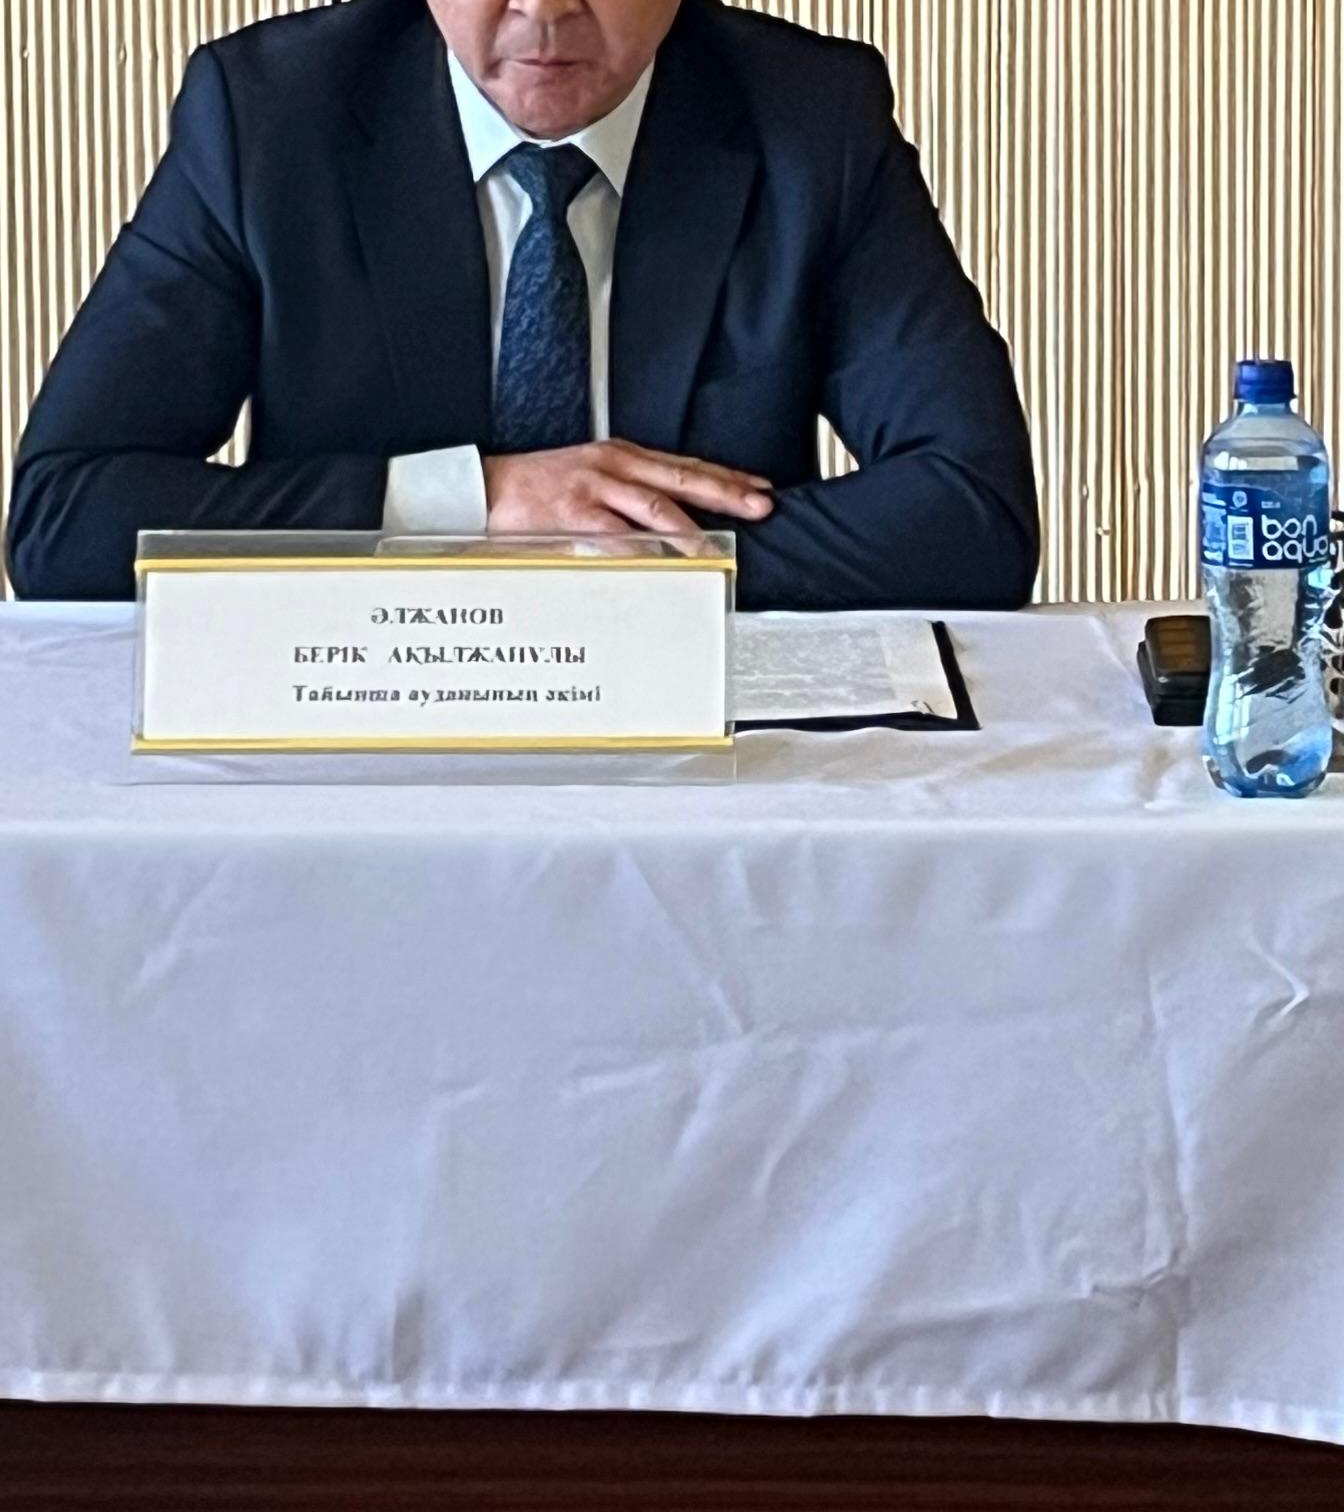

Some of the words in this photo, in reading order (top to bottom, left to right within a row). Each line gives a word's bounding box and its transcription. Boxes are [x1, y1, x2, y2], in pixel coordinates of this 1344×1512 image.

[1261, 514, 1317, 540] bon
[1262, 536, 1329, 564] aqua
[293, 645, 369, 664] БЕРІК
